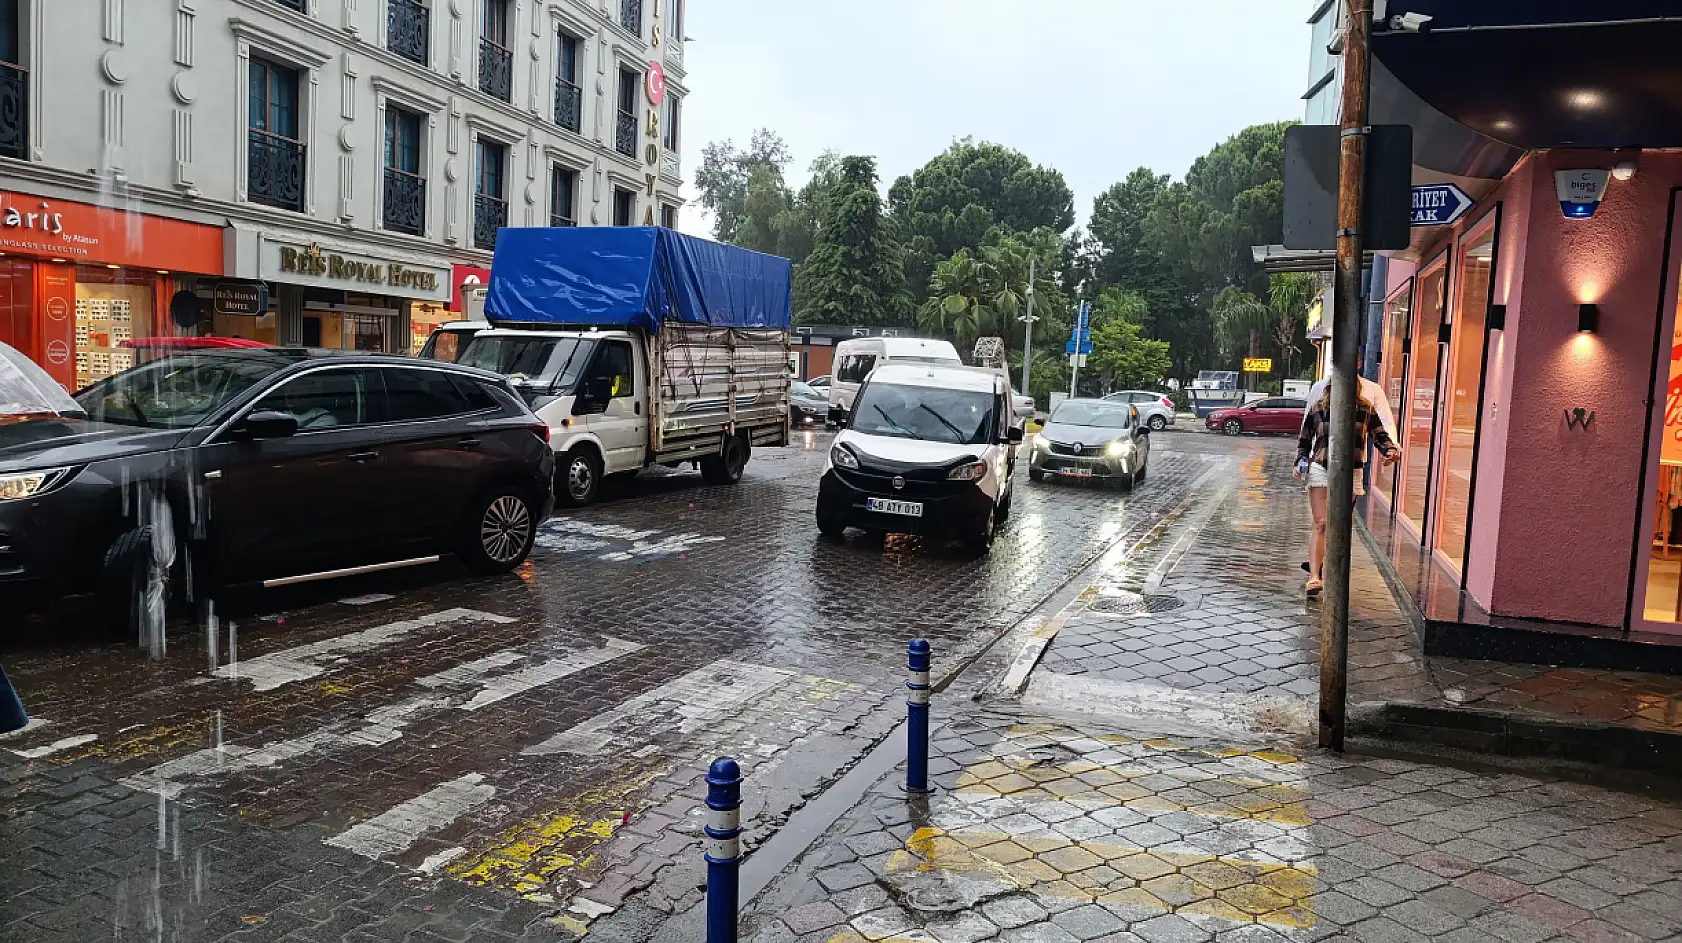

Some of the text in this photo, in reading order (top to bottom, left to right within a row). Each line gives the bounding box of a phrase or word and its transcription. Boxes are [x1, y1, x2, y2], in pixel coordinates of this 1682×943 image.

[0, 194, 63, 235] aris
[0, 238, 88, 255] NGLASS SELECTION
[62, 232, 99, 245] by Atasun
[328, 254, 387, 284] ROYAL
[387, 263, 440, 291] HOTEL
[225, 300, 250, 310] HOTEL
[872, 499, 884, 511] 48
[904, 504, 921, 515] 013
